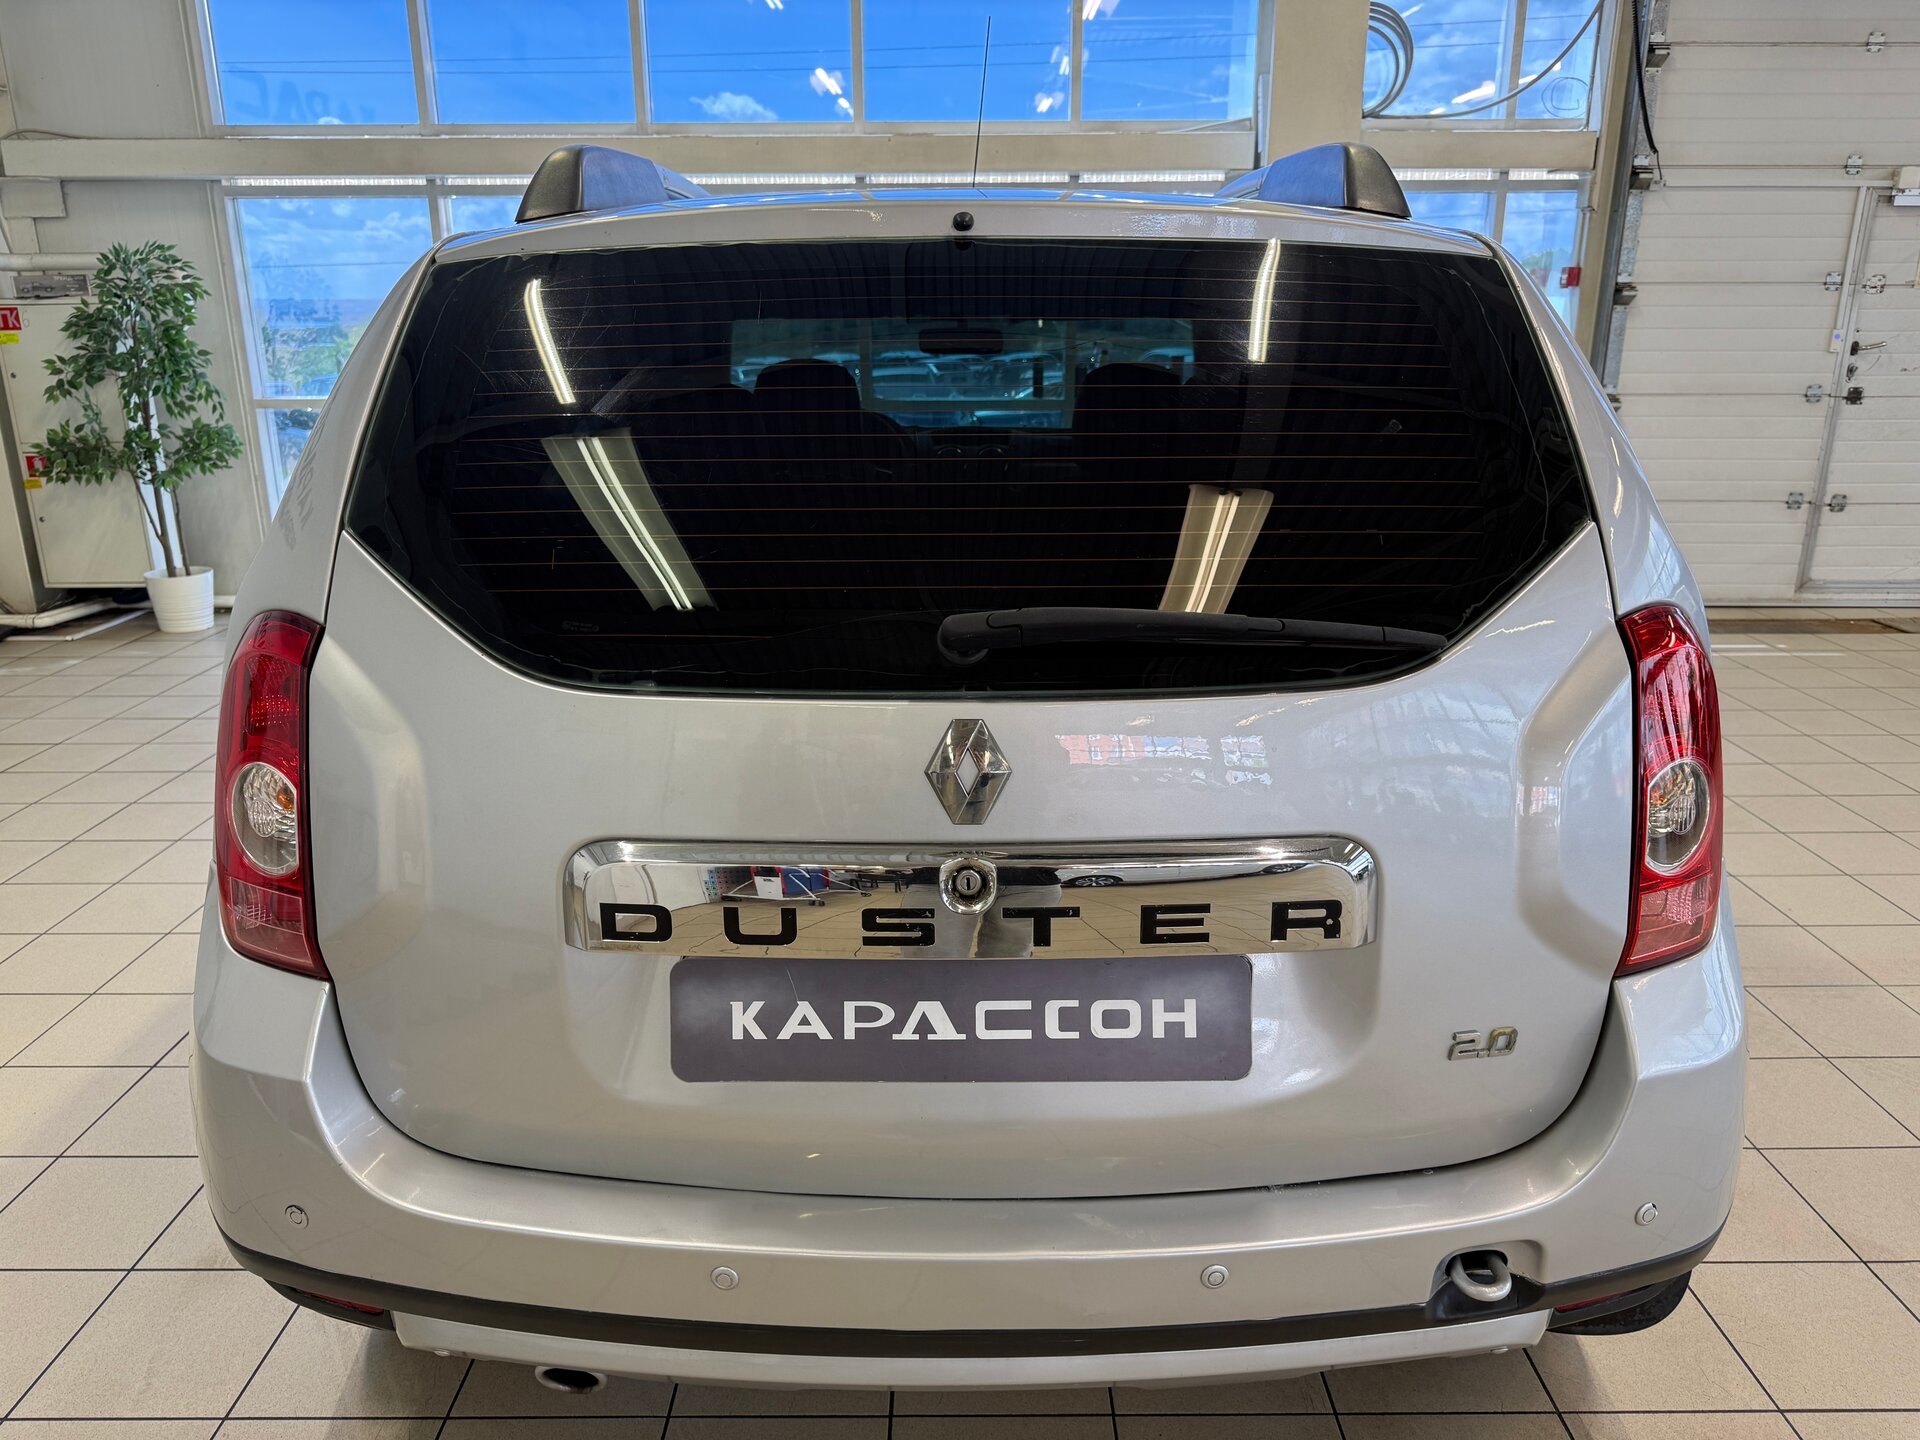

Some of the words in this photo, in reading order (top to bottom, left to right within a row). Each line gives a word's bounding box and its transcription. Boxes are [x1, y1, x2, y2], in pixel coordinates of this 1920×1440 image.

[600, 900, 1343, 945] DUSTER
[730, 999, 1197, 1041] КАРАССОН
[1447, 1026, 1518, 1060] 2.0
